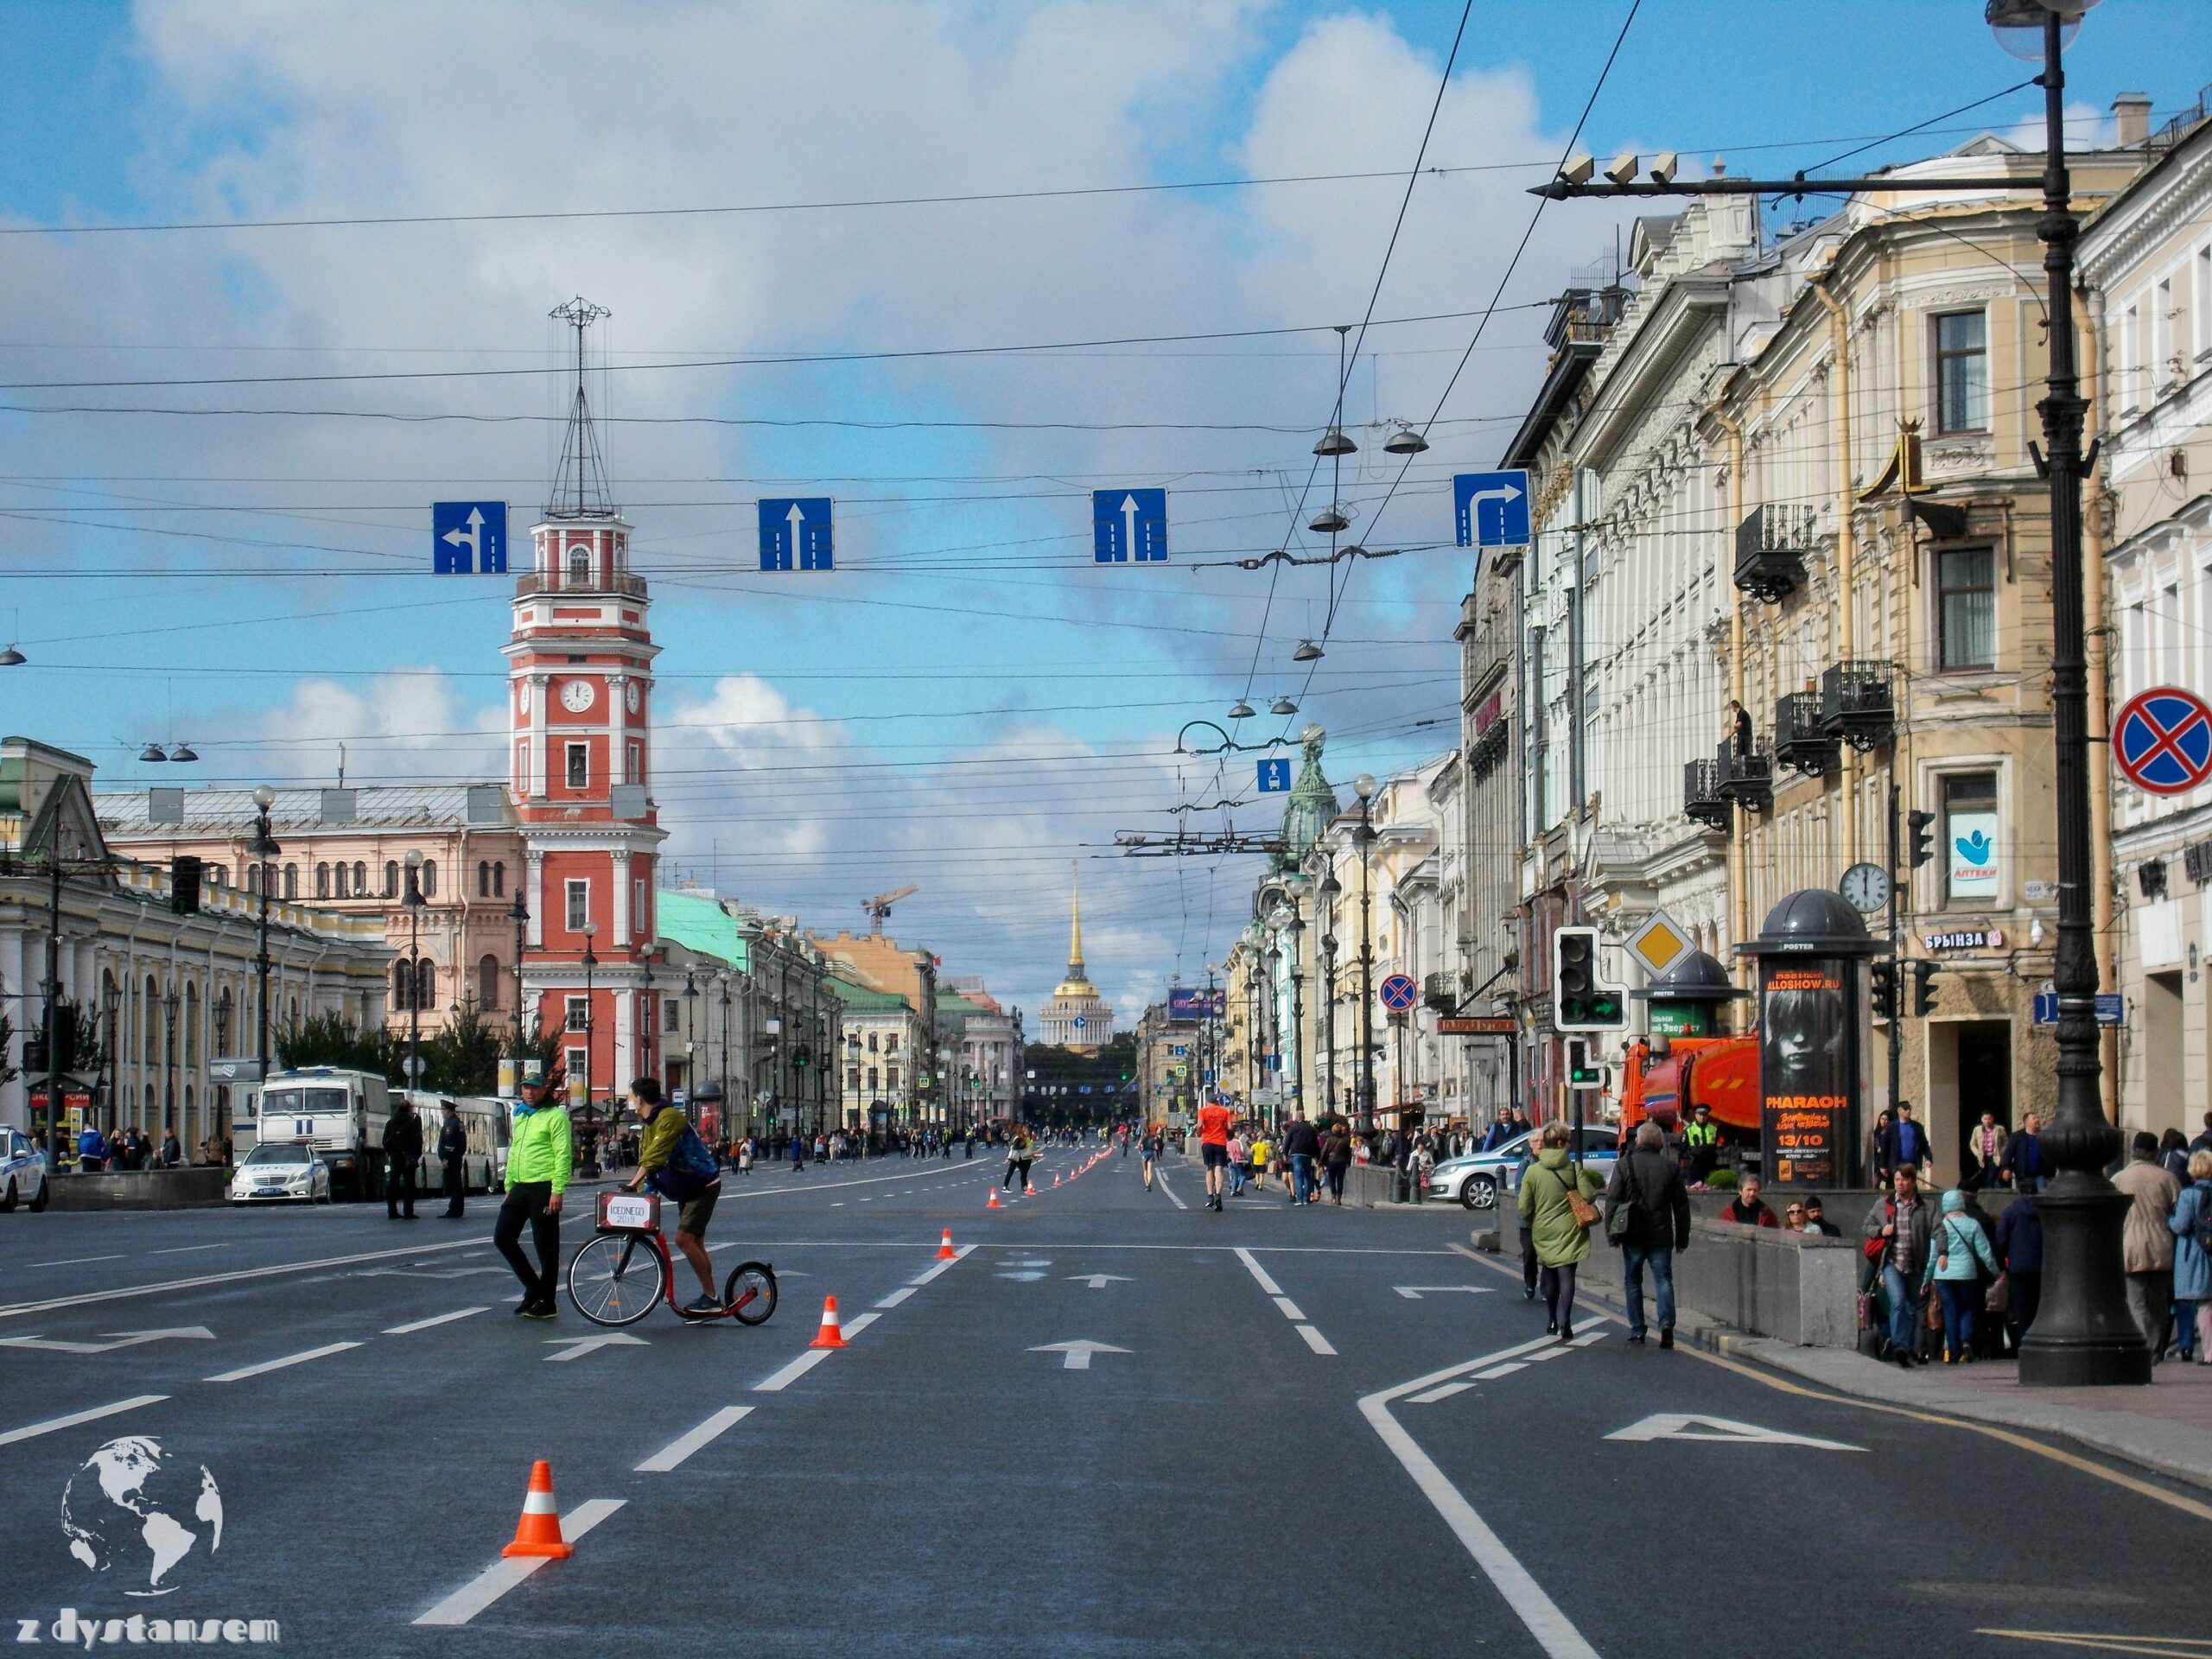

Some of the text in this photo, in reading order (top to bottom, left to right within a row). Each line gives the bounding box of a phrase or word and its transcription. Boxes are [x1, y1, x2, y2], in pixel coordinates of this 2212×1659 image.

[1955, 868, 1998, 878] АПТЕКИ
[1925, 932, 1983, 949] БРЫНЗА
[1767, 979, 1840, 990] ALLOSHOW.RU
[1662, 1023, 1700, 1033] Эверст
[1765, 1096, 1847, 1109] PHARAOH
[1778, 1133, 1823, 1147] 13/10
[617, 1215, 635, 1224] 2019
